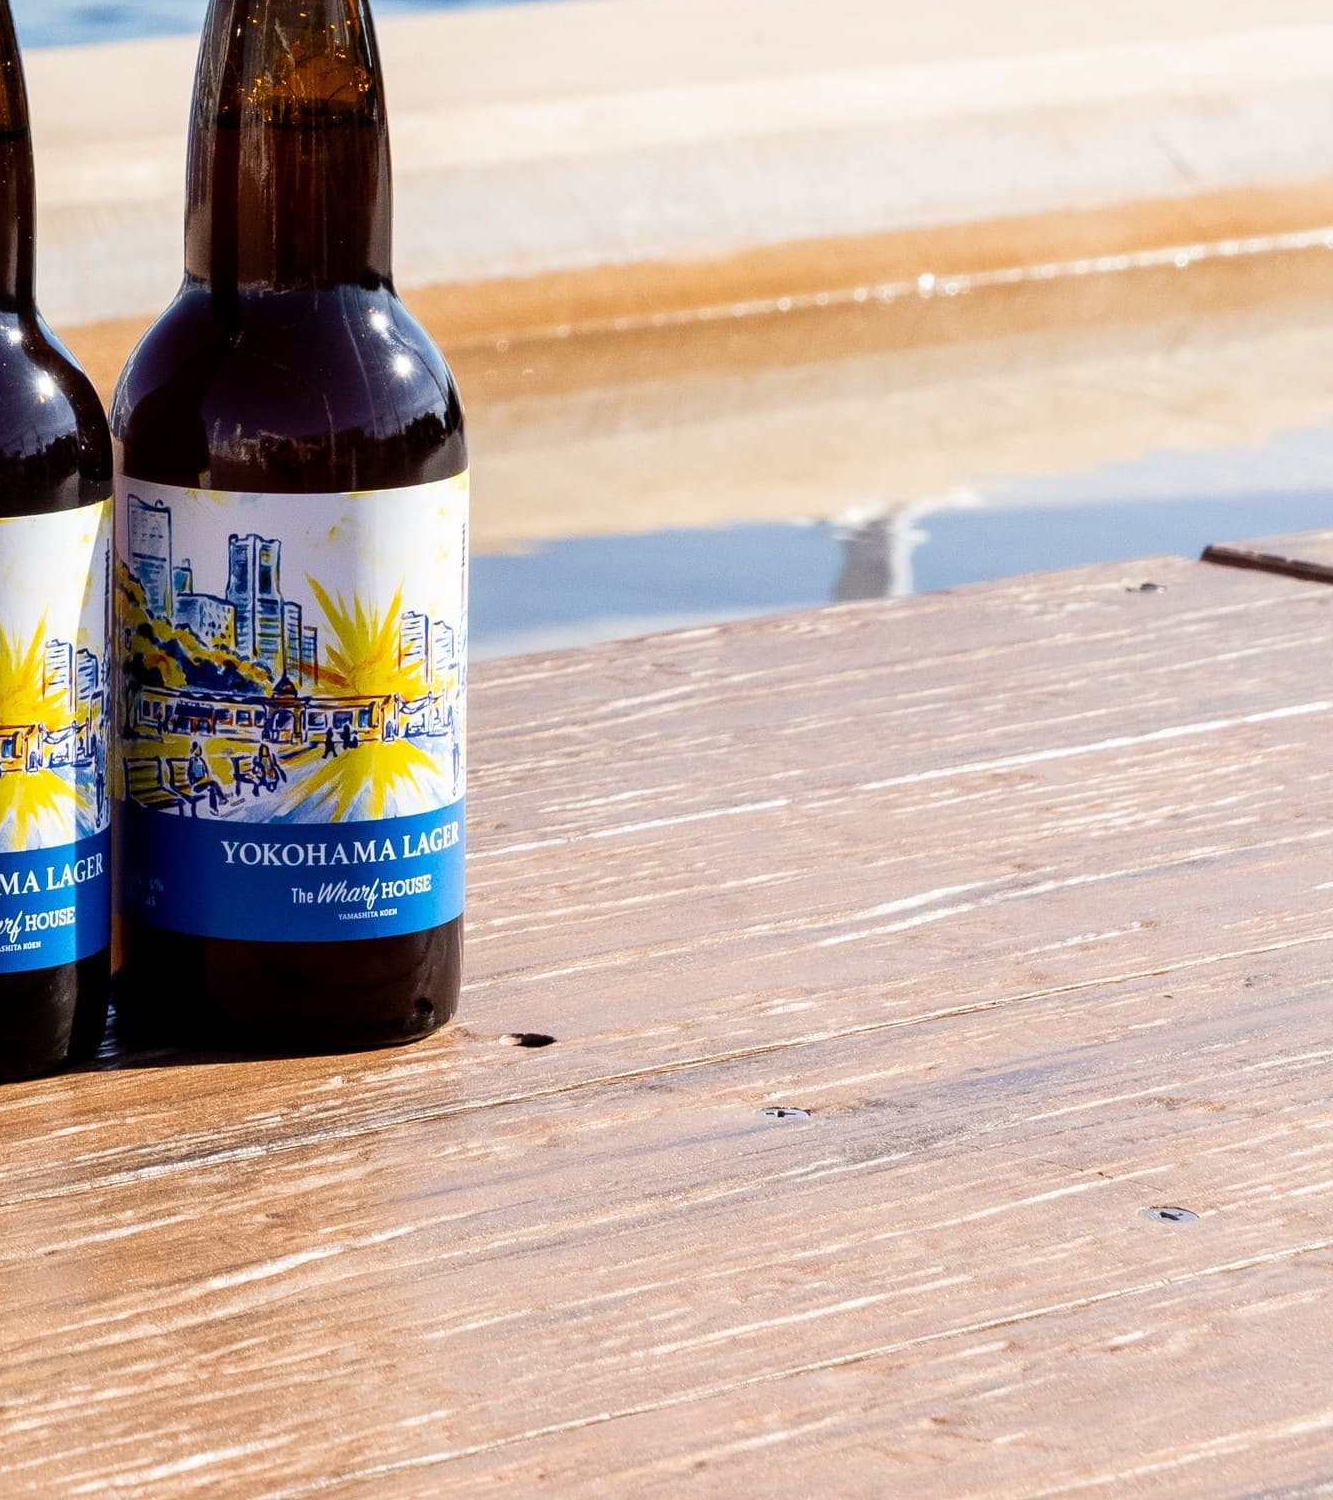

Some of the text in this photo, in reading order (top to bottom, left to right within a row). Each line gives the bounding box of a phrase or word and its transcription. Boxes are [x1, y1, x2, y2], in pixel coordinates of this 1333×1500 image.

[221, 821, 459, 866] YOKOHAMA LAGER
[46, 853, 103, 891] LAGER
[291, 874, 432, 910] The Wharf HOUSE
[25, 906, 76, 931] HOUSE
[338, 911, 379, 920] YAMASHITA
